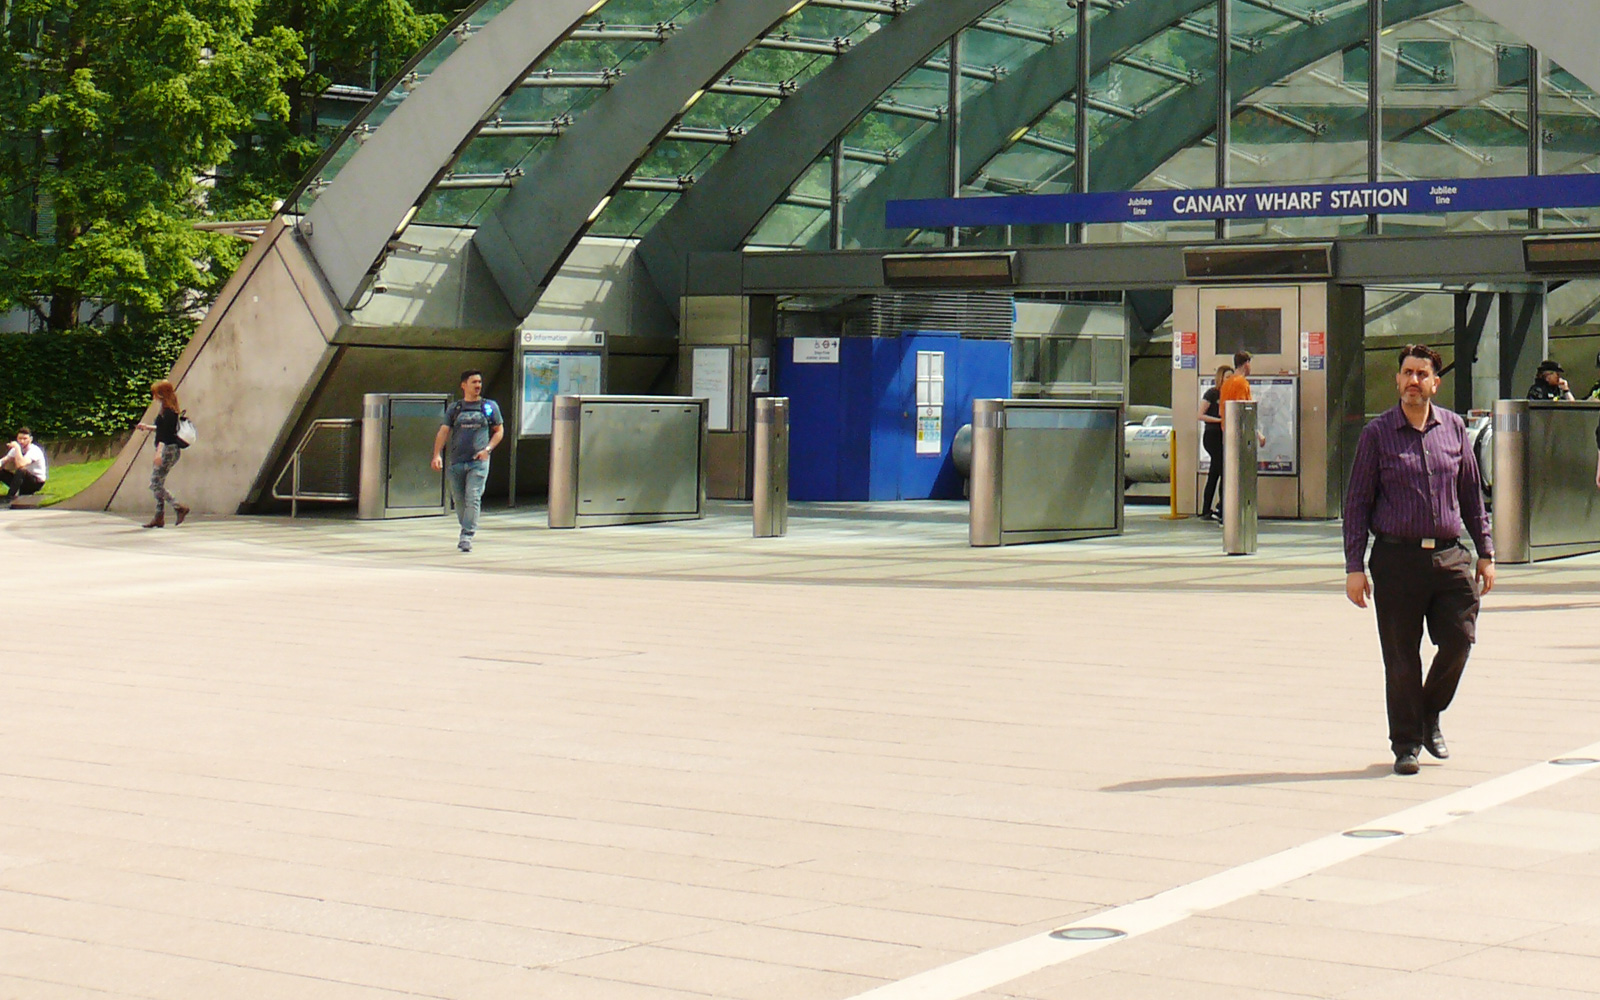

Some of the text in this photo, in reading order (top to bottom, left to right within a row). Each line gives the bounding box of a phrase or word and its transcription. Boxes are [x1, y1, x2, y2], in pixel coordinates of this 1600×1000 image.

[1429, 185, 1458, 195] Jubilee
[1127, 197, 1153, 206] Jubilee
[1172, 187, 1408, 214] CANARY WHARF STATION
[1435, 195, 1450, 205] line
[1132, 206, 1147, 215] line
[534, 333, 568, 342] Information
